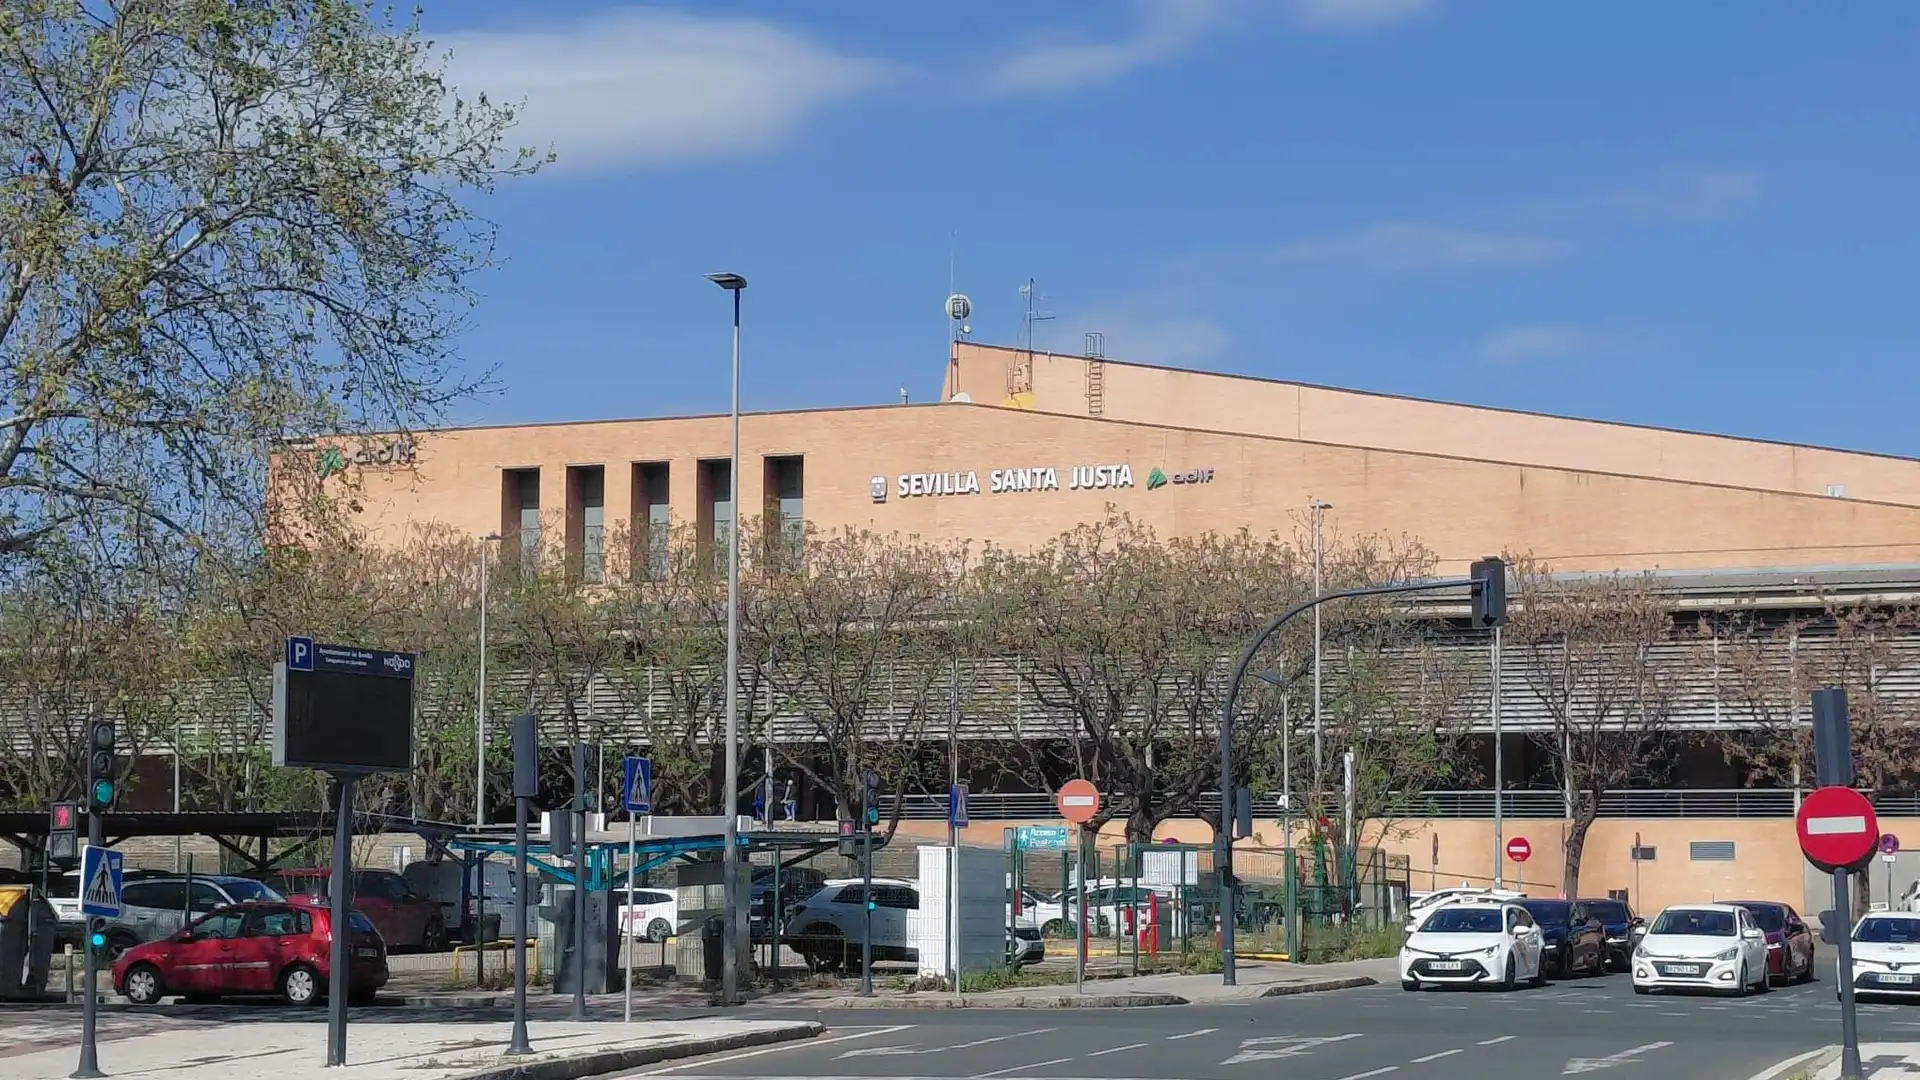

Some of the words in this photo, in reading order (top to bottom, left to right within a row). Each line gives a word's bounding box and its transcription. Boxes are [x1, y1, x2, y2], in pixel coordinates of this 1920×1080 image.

[898, 471, 980, 498] SEVILLA
[990, 467, 1059, 493] SANTA
[1069, 464, 1135, 491] JUSTA
[295, 643, 307, 664] P
